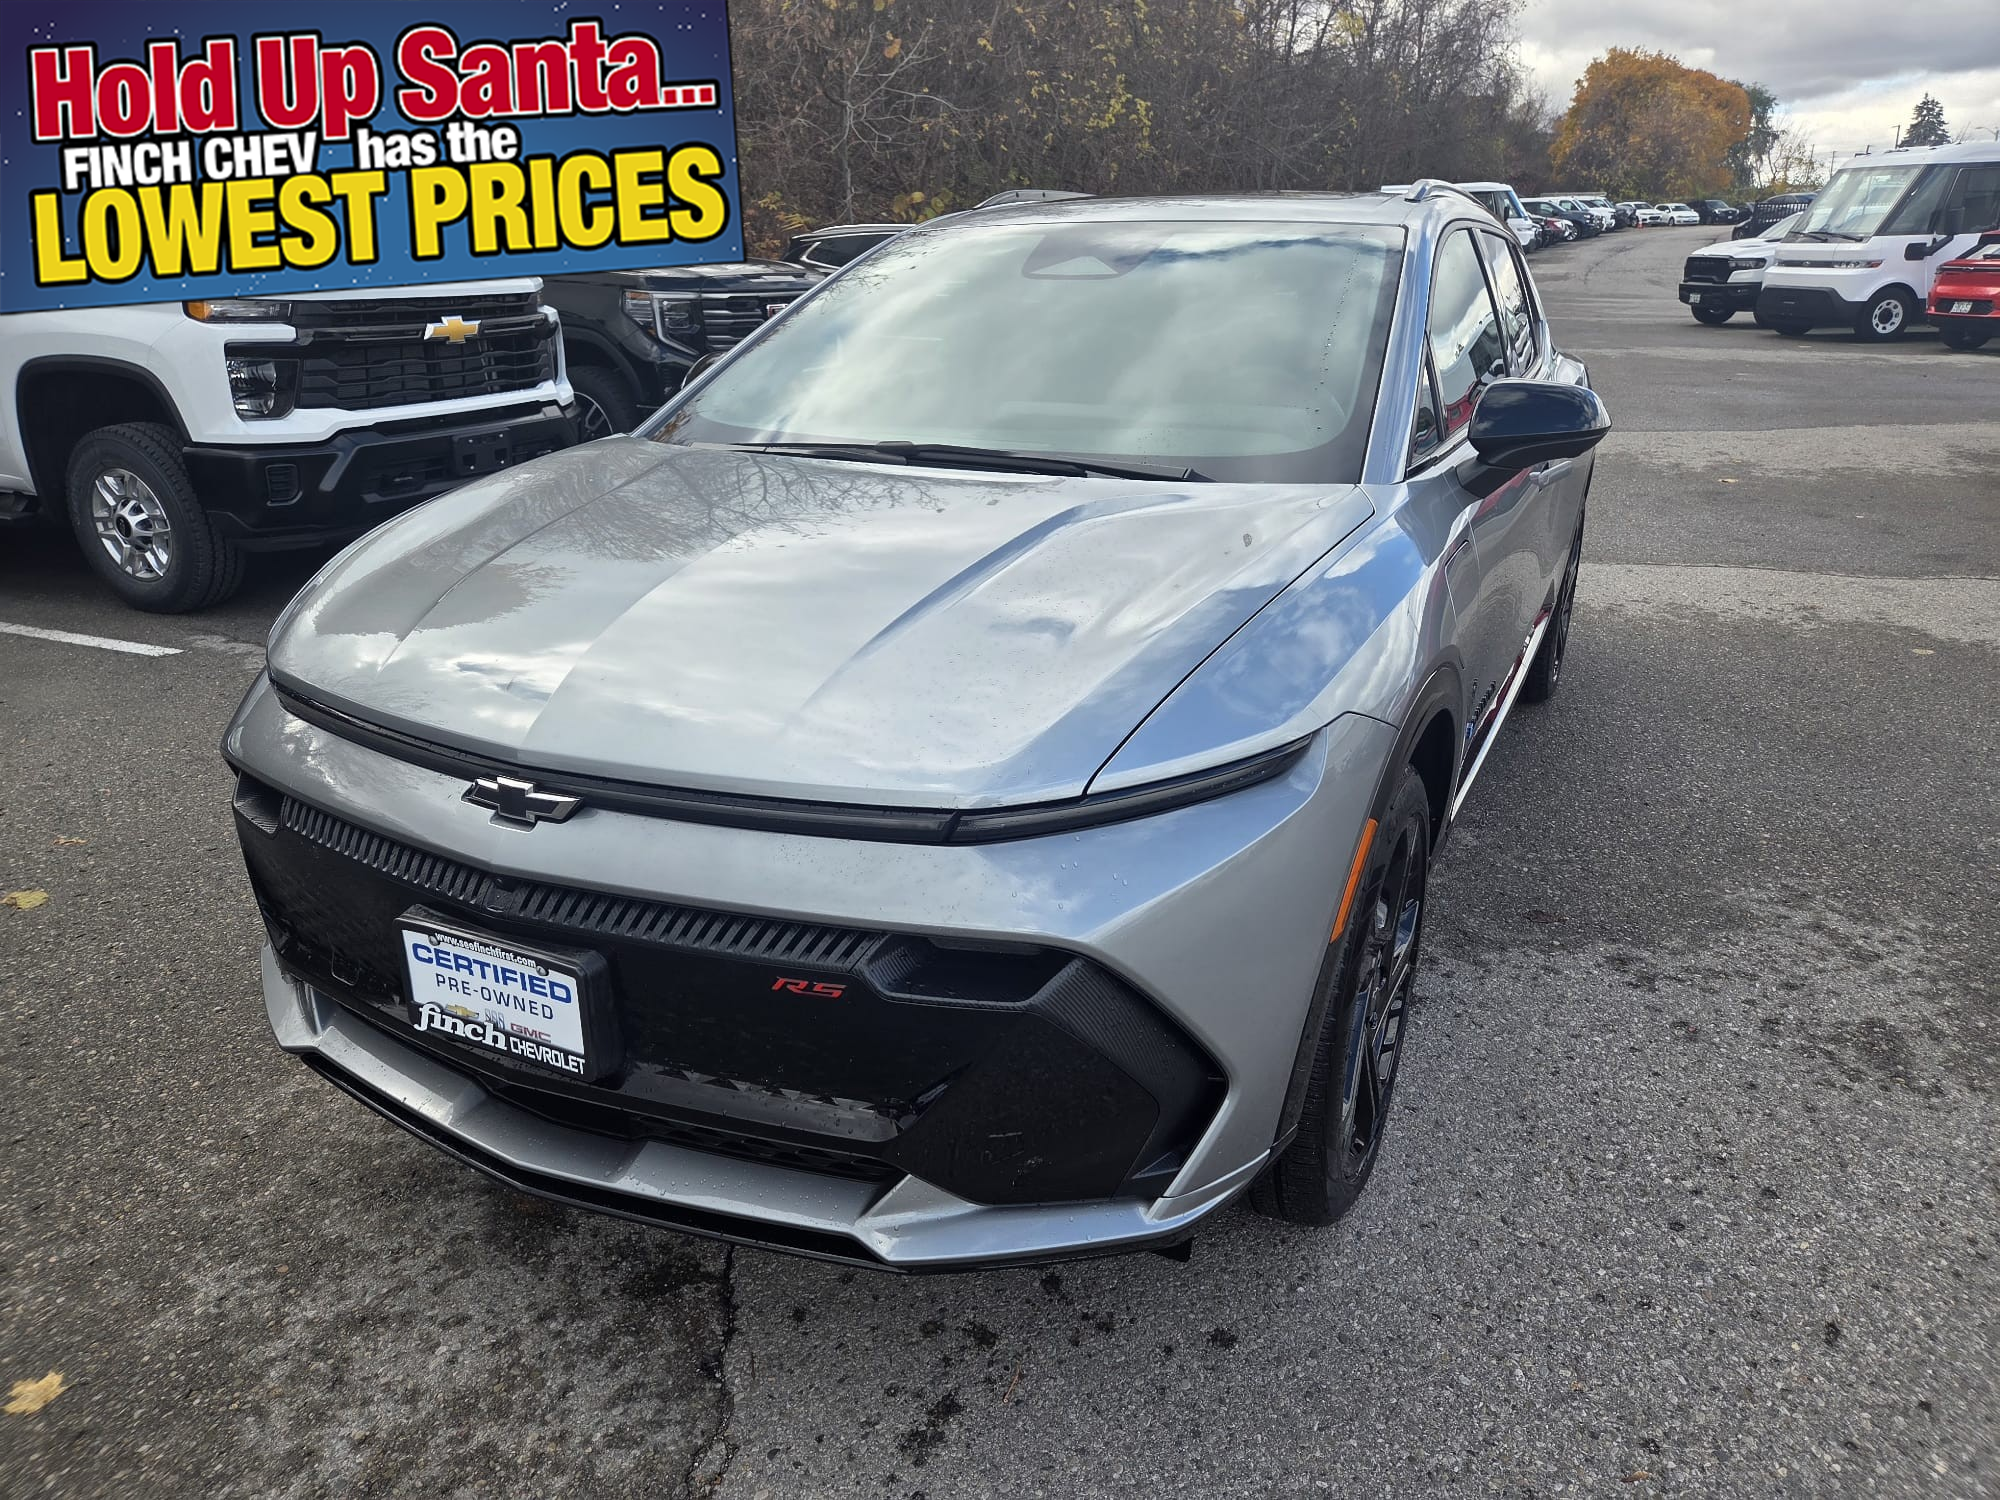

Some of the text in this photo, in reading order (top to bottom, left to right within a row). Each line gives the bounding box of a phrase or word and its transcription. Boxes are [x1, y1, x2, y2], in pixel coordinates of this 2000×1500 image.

[412, 942, 572, 1004] CERTIFIED
[435, 973, 554, 1020] PRE-OWNED
[771, 976, 848, 998] RS
[413, 1002, 586, 1075] finch CHEVROLET
[510, 1023, 552, 1043] GMC
